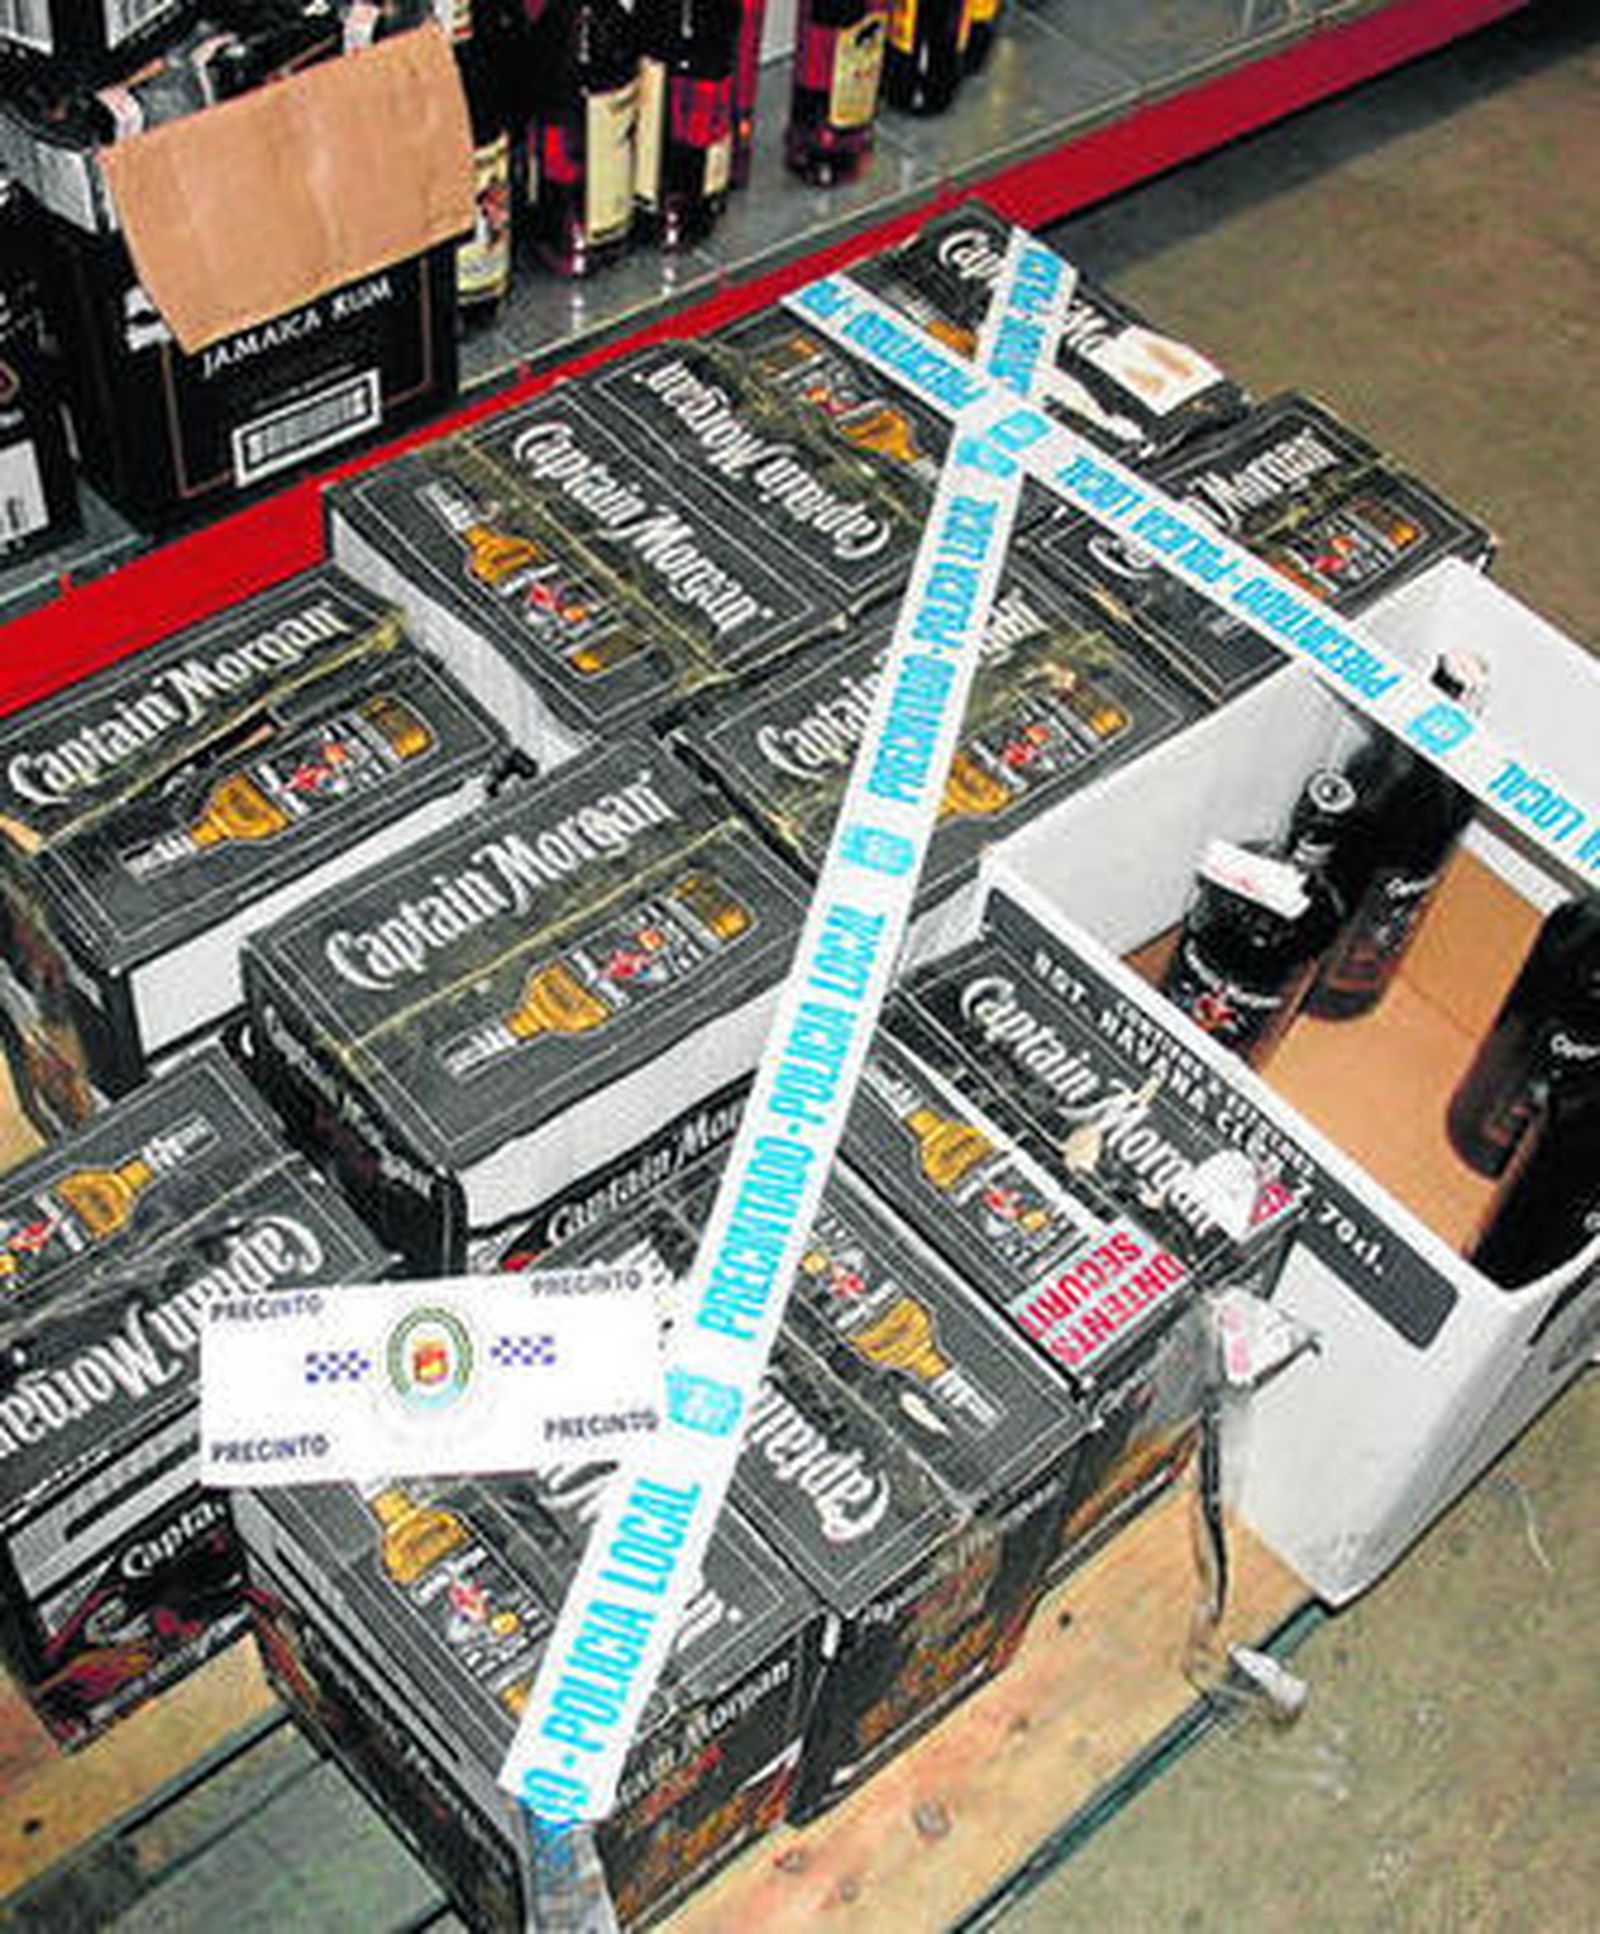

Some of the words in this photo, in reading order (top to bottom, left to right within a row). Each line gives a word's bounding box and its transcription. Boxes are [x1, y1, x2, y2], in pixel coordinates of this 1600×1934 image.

[201, 312, 322, 377] JAMAICA
[332, 279, 393, 321] RUM
[647, 361, 794, 487] Morgan
[512, 421, 644, 537] Captain
[602, 505, 762, 635] Morgan
[755, 445, 891, 560] Captain
[7, 687, 182, 805] Captain
[157, 602, 347, 728] Morgan
[1489, 762, 1585, 841] LOCAL
[324, 856, 510, 991] Captain
[473, 775, 680, 916] Morgan
[808, 904, 887, 1000] LOCAL
[768, 1001, 859, 1127] POLICIA
[961, 975, 1101, 1112] Captain
[546, 1147, 678, 1249] Captain
[1099, 1010, 1208, 1115] HAVANA
[1316, 1200, 1386, 1278] 70cl.
[530, 1269, 644, 1299] PRECINTO
[695, 1135, 815, 1342] PRECINTADO
[209, 1293, 325, 1324] PRECINTO
[1050, 1252, 1186, 1364] ONTENTS
[209, 1433, 331, 1465] PRECINTO
[543, 1409, 659, 1442] PRECINTO
[599, 1478, 702, 1596] LOCAL
[541, 1600, 658, 1753] POLICIA
